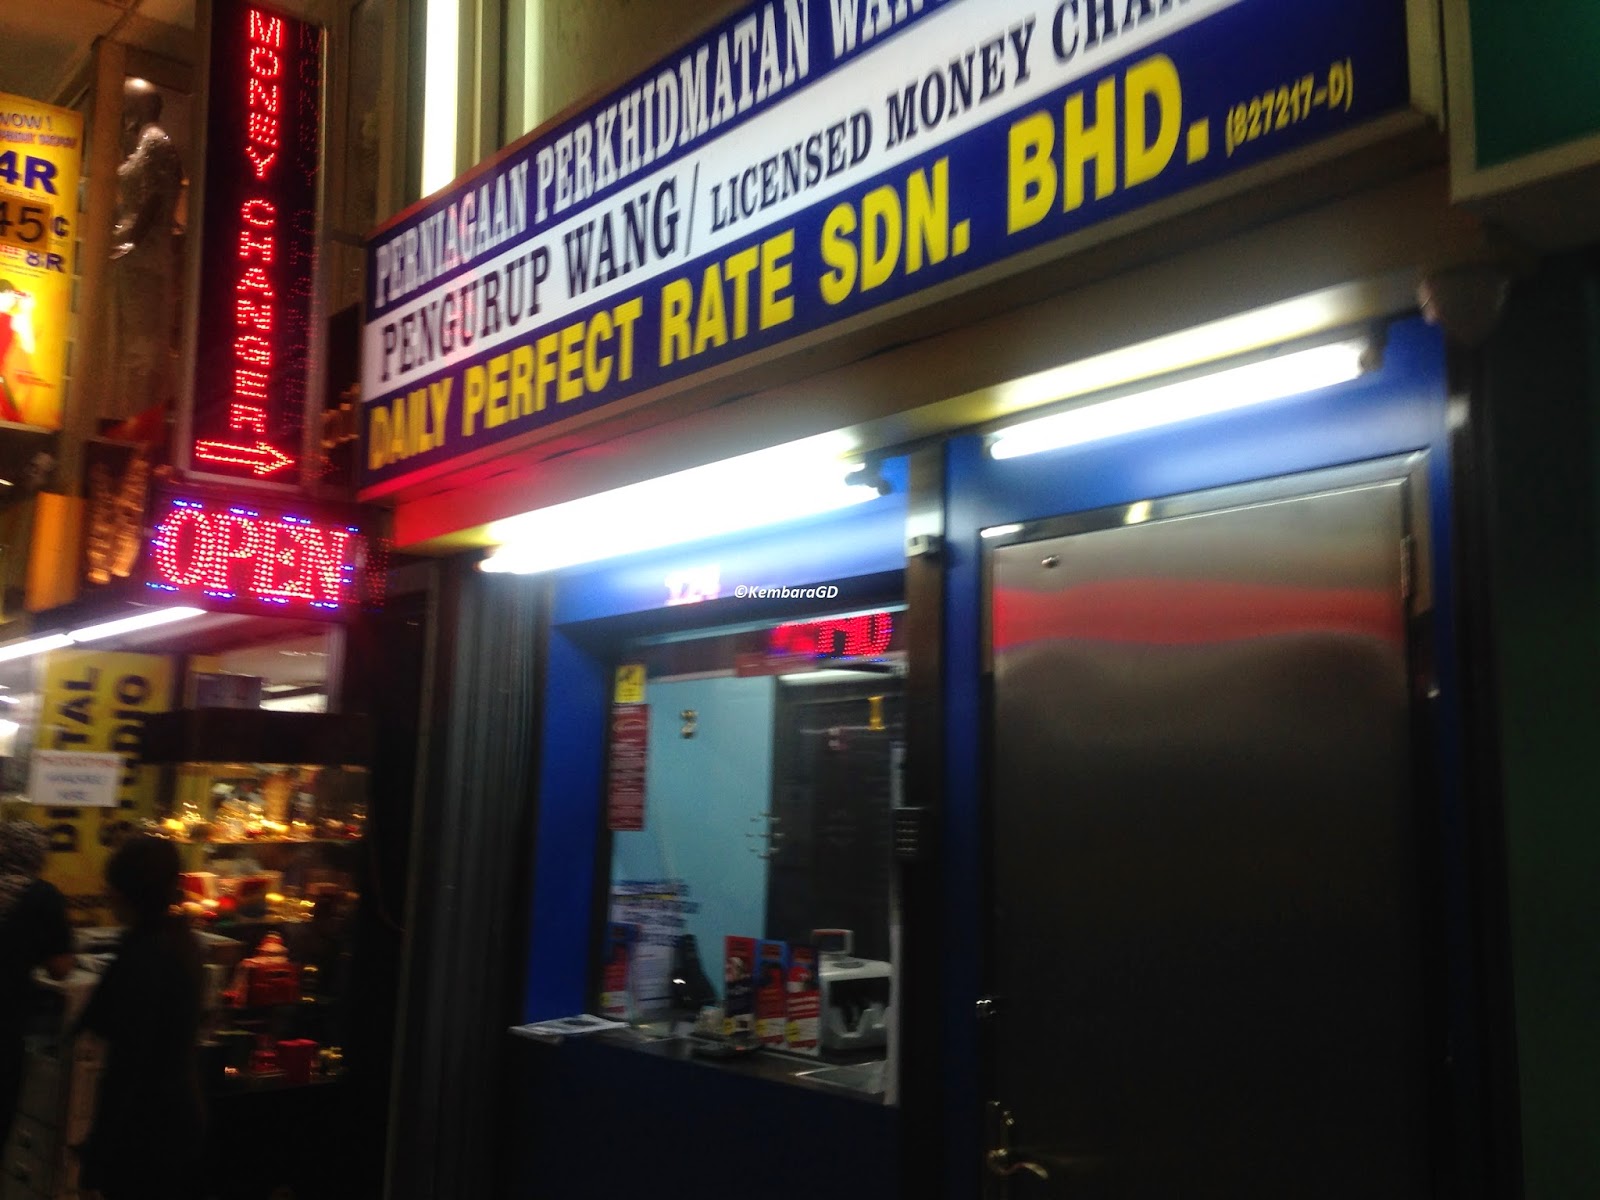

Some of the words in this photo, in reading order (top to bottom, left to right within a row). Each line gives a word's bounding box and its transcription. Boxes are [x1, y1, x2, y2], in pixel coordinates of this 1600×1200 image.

[0, 150, 59, 195] 4R
[246, 8, 282, 177] MONEY
[374, 157, 528, 310] PERNIAGAAN
[534, 0, 810, 222] PERKHIDMATAN
[380, 244, 552, 383] PENGURUP
[709, 107, 872, 233] LICENSED
[886, 12, 1037, 150] MONEY
[230, 198, 277, 434] CHANGER
[368, 376, 454, 471] DAILY
[461, 296, 643, 437] PERFECT
[659, 228, 796, 368] RATE
[818, 155, 971, 306] SDN.
[1006, 51, 1210, 236] BHD.
[155, 507, 349, 602] OPEN
